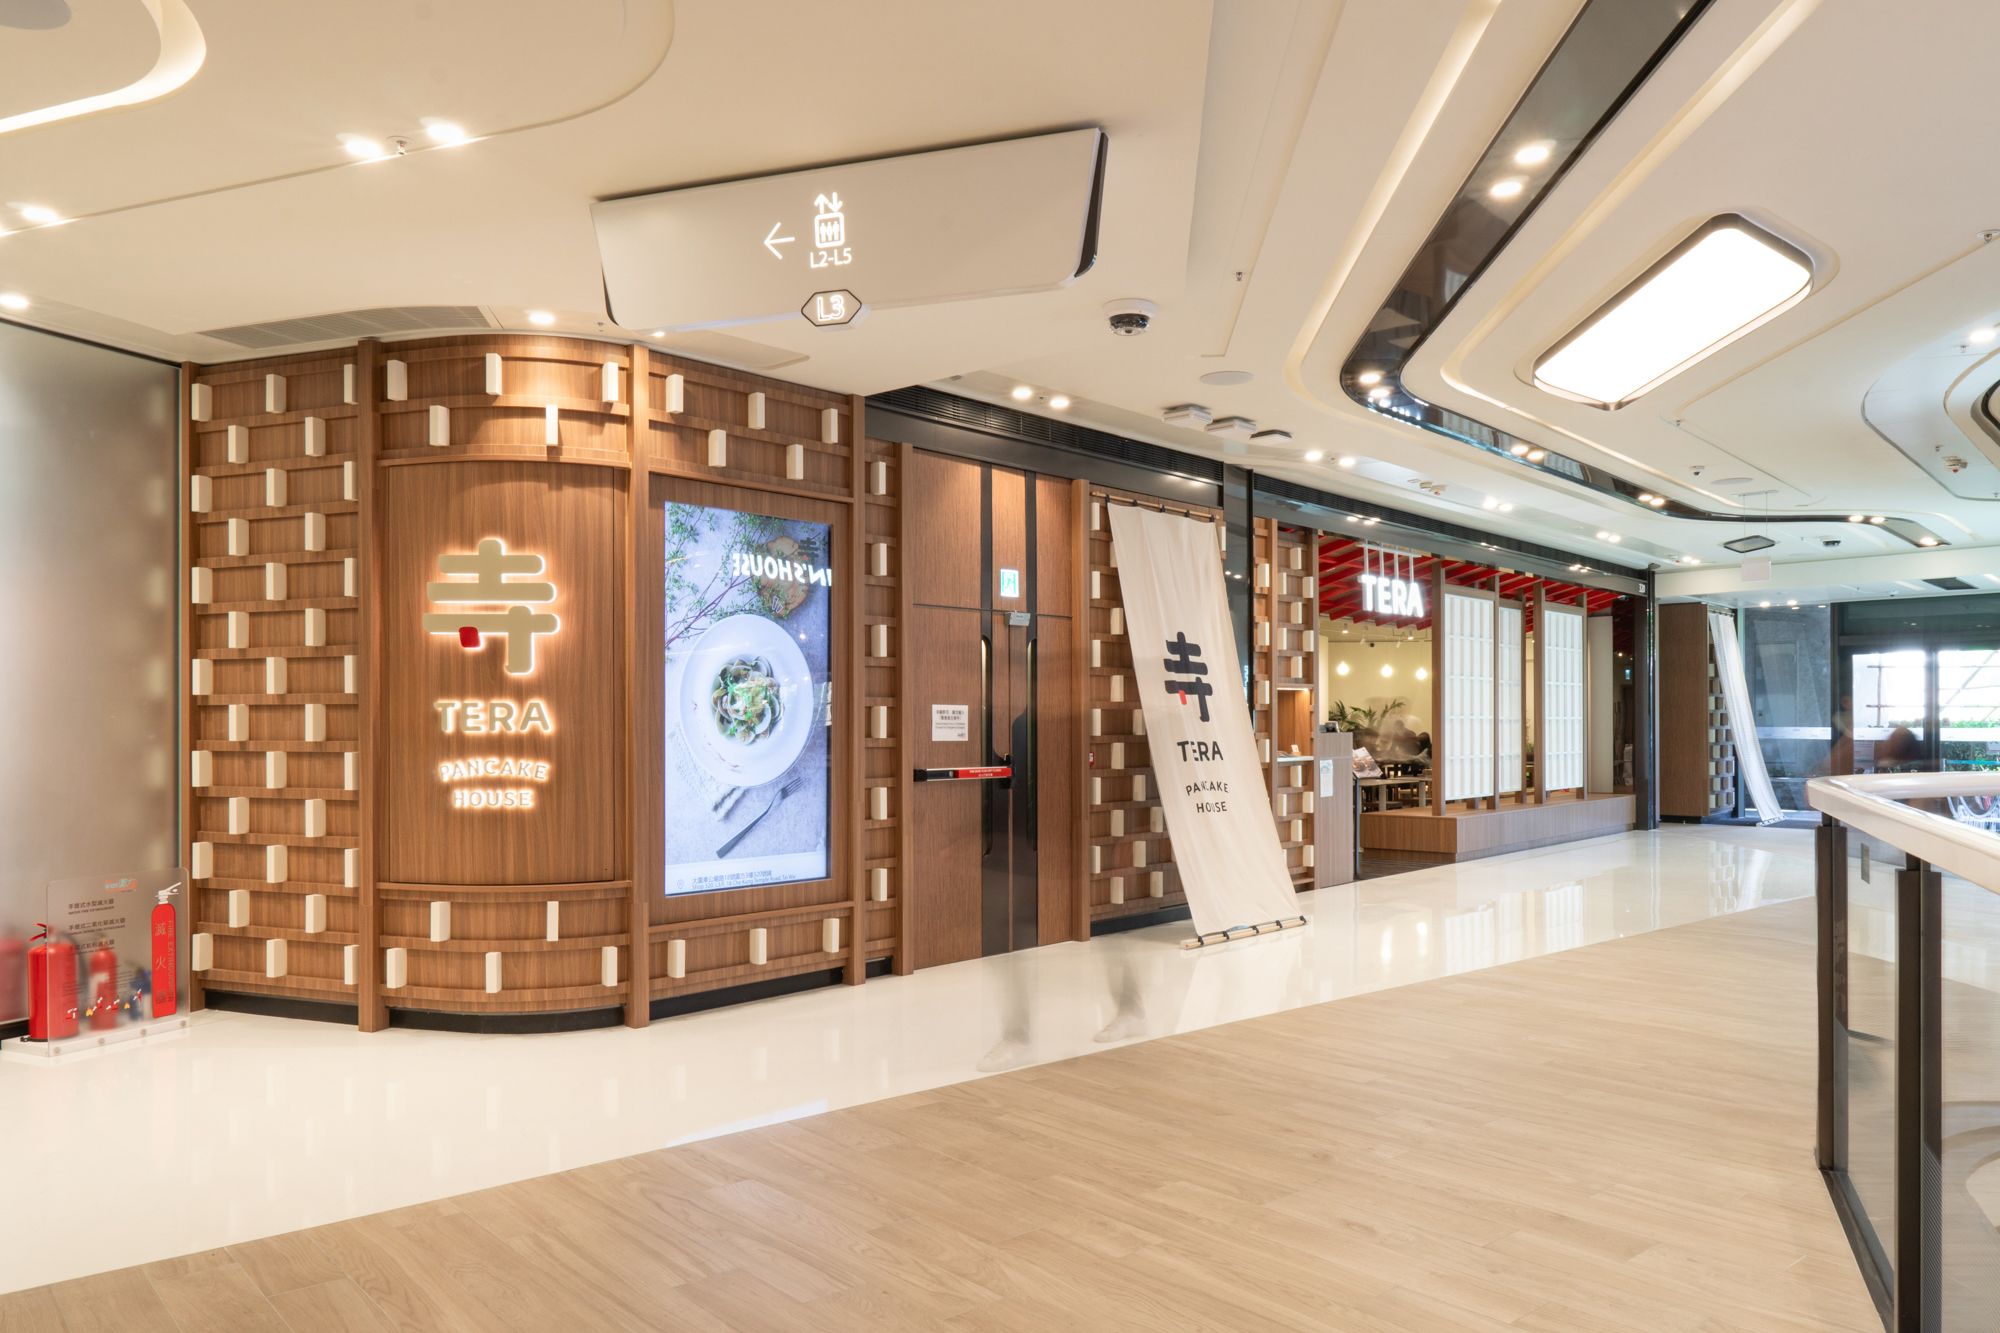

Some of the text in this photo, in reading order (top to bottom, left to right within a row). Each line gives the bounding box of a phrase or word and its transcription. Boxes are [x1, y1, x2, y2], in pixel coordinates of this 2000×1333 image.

[810, 248, 852, 268] L2-L5
[817, 295, 845, 321] L3
[1358, 574, 1424, 618] TERA
[434, 700, 552, 733] TERA
[439, 757, 550, 783] PANCAKE
[453, 789, 533, 808] HOUSE
[1186, 780, 1229, 796] PANAKE
